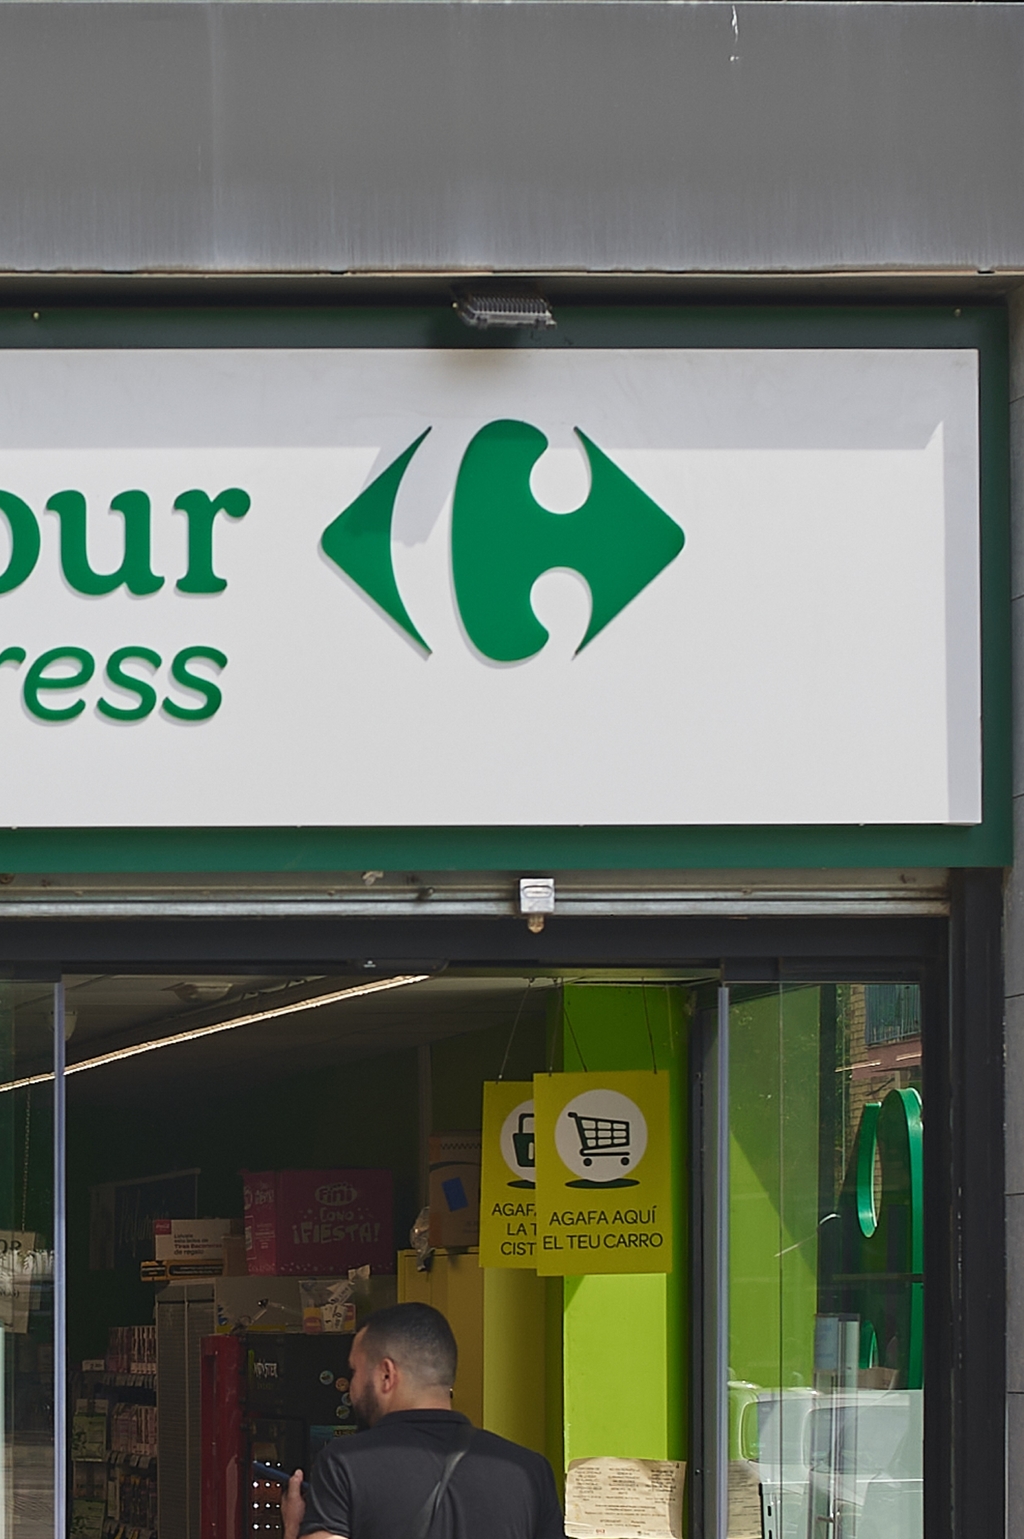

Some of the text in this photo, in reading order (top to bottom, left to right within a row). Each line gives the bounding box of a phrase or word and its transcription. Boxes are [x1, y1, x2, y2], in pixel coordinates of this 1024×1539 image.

[492, 1203, 536, 1216] AGAF
[549, 1205, 657, 1226] AGAFA AQUÍ
[292, 1221, 381, 1245] ¡FIESTA!
[507, 1223, 527, 1236] LA
[543, 1233, 663, 1250] EL TEU CARRO
